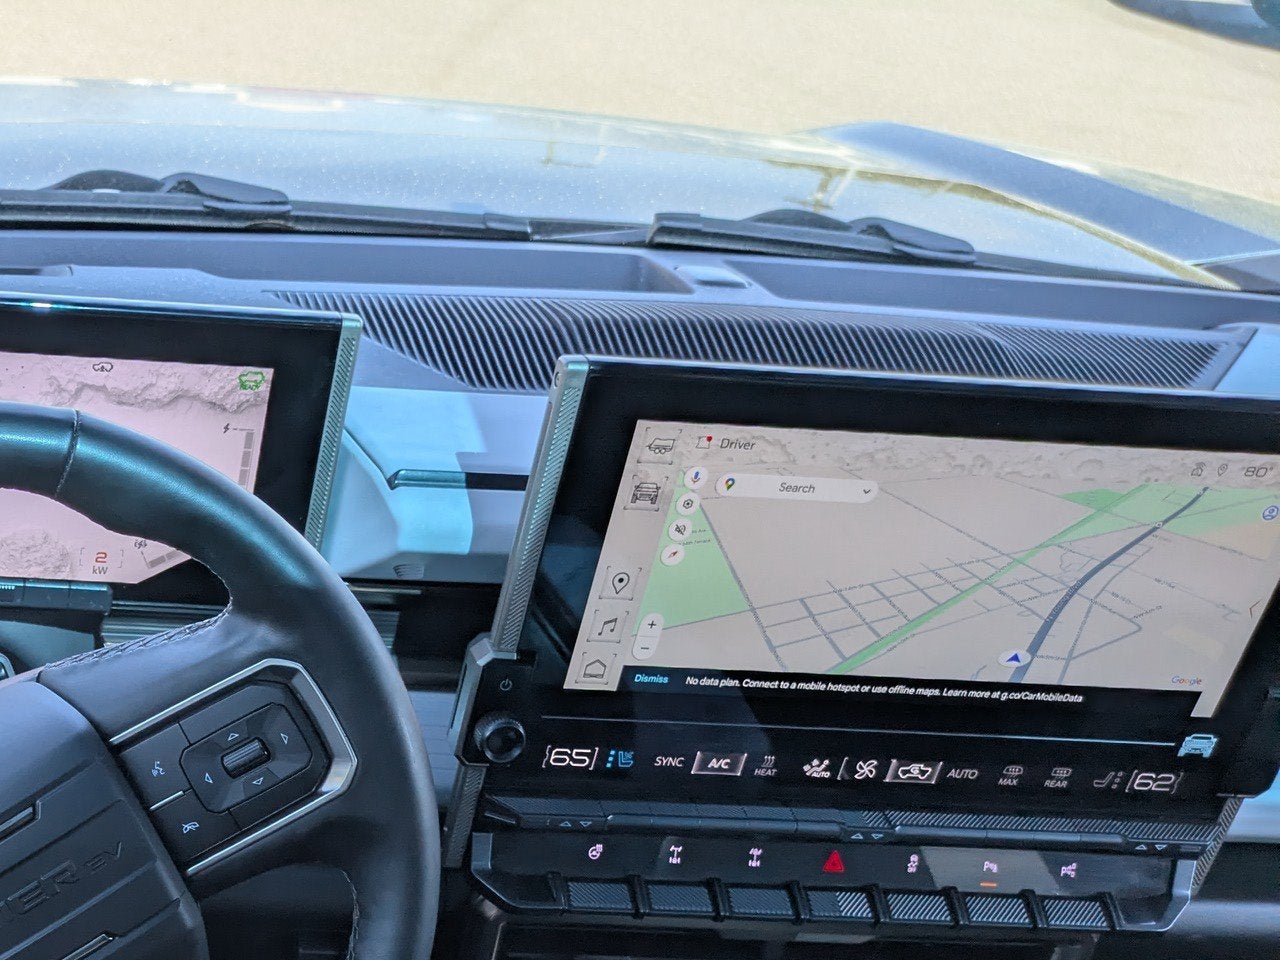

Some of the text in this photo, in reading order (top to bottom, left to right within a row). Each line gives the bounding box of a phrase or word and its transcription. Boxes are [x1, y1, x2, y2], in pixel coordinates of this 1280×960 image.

[720, 438, 756, 451] Driver
[779, 482, 815, 494] Search
[95, 551, 107, 563] 2
[92, 565, 107, 575] kW
[634, 674, 669, 684] Dismiss
[1171, 675, 1202, 686] Google
[685, 676, 698, 685] No
[699, 677, 719, 686] data
[719, 677, 740, 688] plan.
[742, 679, 778, 689] Connect
[779, 680, 789, 689] to
[797, 681, 826, 690] mobile
[827, 682, 860, 693] hotspot
[888, 685, 915, 695] offline
[915, 688, 941, 697] maps.
[943, 688, 967, 697] Learn
[968, 690, 990, 699] more
[991, 690, 1000, 699] at
[1000, 691, 1083, 703] g.co/CarMobileData
[550, 748, 593, 767] 65
[654, 756, 684, 768] SYNC
[707, 758, 730, 770] A/C
[754, 768, 777, 777] HEAT
[811, 770, 830, 778] AUTO
[947, 768, 978, 780] AUTO
[998, 778, 1019, 786] MAX
[1044, 780, 1067, 789] REAR
[1133, 772, 1176, 791] 62
